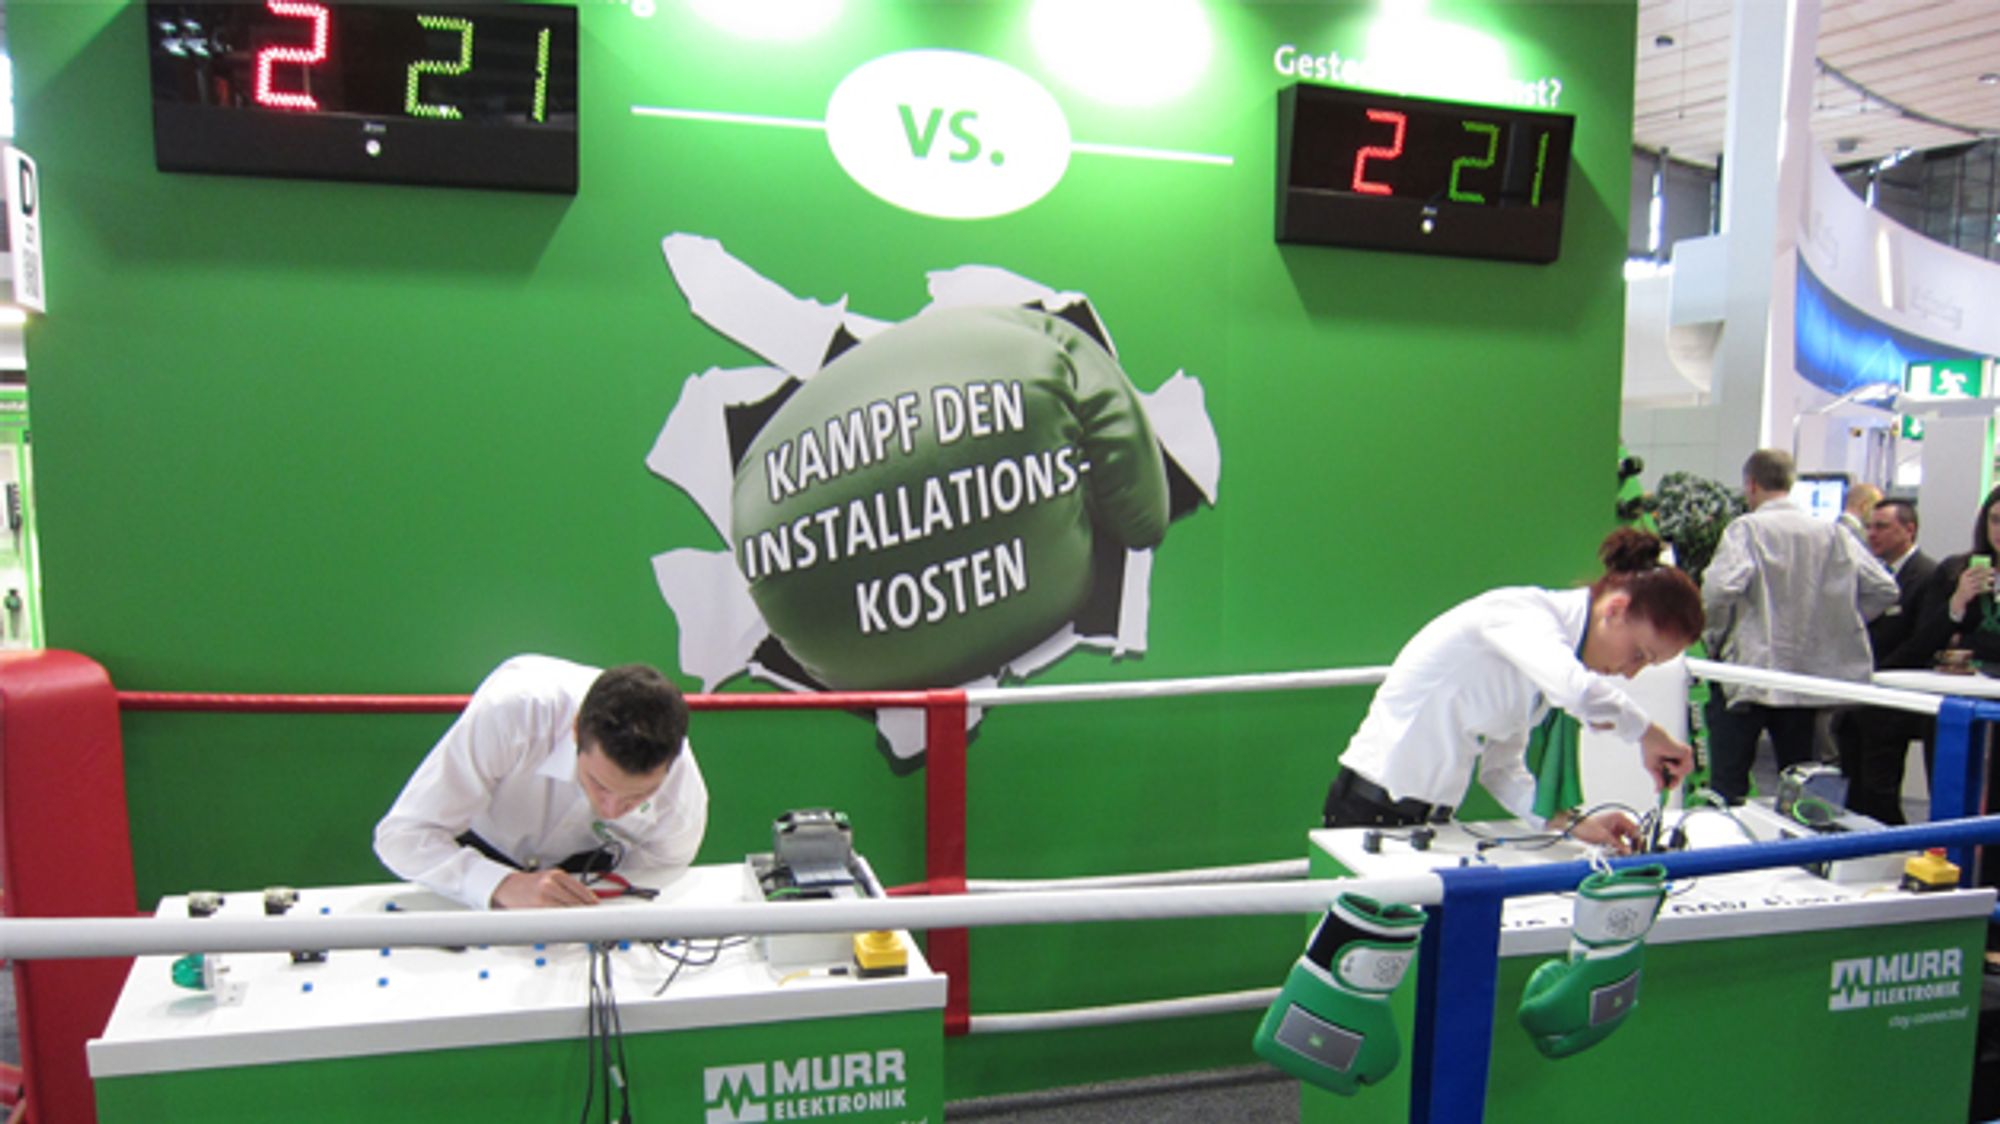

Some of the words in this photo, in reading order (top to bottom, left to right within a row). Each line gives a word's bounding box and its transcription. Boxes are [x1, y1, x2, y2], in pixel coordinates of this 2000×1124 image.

[258, 0, 329, 110] 2
[1353, 108, 1407, 196] 2
[766, 393, 921, 502] KAMPF
[932, 381, 1025, 444] DEN
[744, 447, 1091, 579] INSTALLATIONS-
[856, 537, 1027, 633] KOSTEN
[1873, 981, 1960, 1006] ELEKTRONIK
[1875, 948, 1963, 985] MURR
[773, 1049, 906, 1095] MURR
[774, 1089, 906, 1120] ELEKTRONIK
